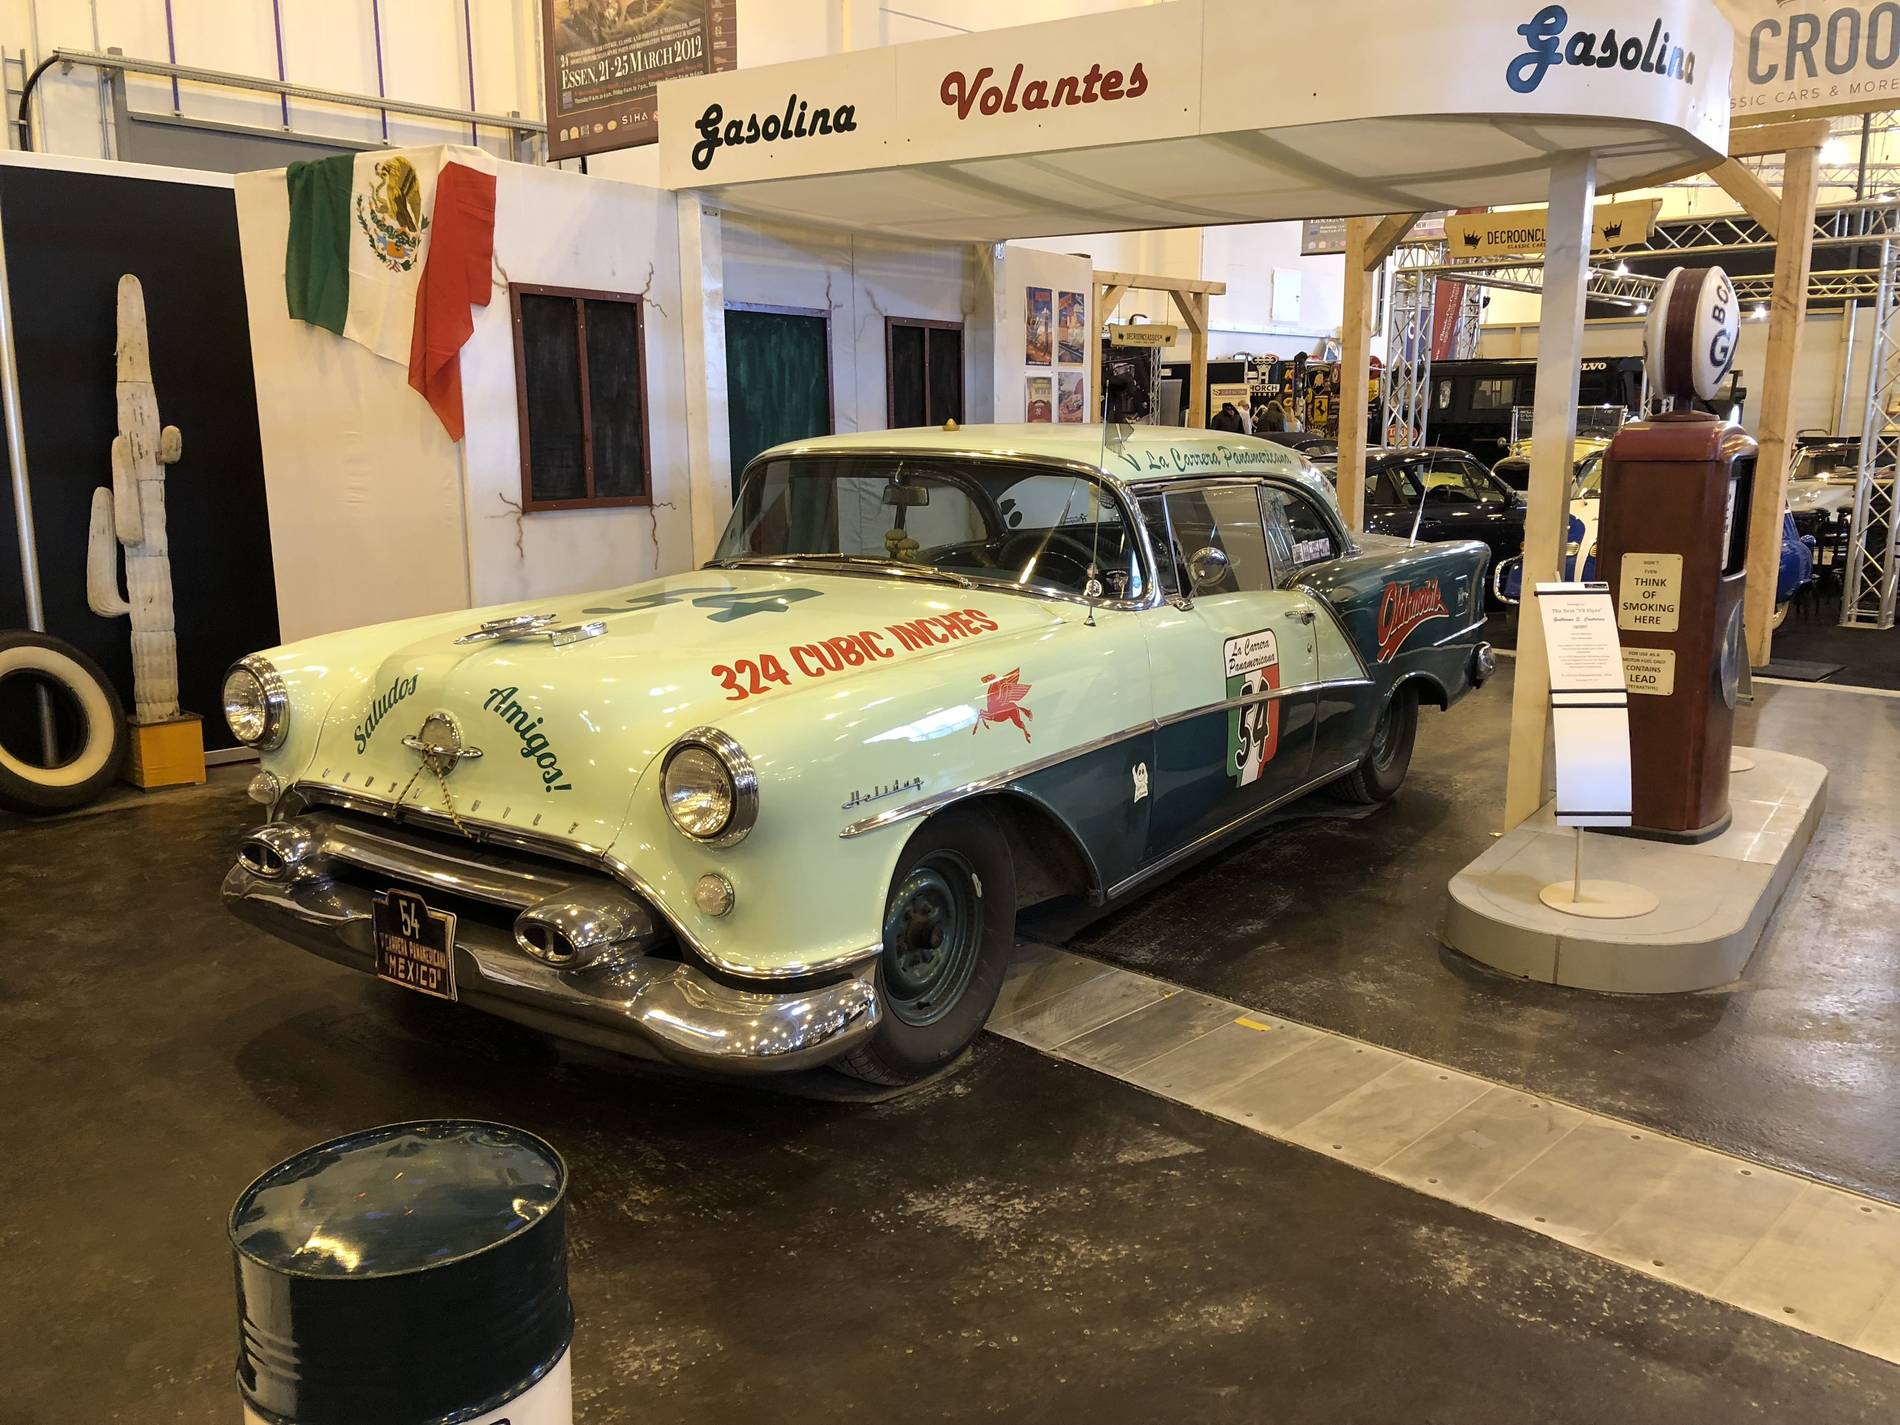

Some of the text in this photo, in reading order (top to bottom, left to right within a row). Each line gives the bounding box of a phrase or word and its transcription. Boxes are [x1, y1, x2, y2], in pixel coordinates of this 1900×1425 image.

[1505, 4, 1696, 94] Gasolina
[1747, 2, 1900, 85] CROO
[561, 67, 598, 89] ESSEN,
[629, 47, 673, 73] MARCH
[674, 35, 703, 63] 2012
[940, 62, 1149, 120] Volantes
[1775, 88, 1820, 103] CARS
[1829, 85, 1839, 96] &
[1849, 78, 1900, 95] MORE
[621, 111, 649, 125] SIHA
[691, 94, 857, 170] Gasolina
[1580, 362, 1607, 371] LVO
[1145, 450, 1170, 470] La
[1170, 448, 1220, 472] Carrera
[1217, 445, 1292, 467] Panamericana
[1634, 577, 1667, 587] THINK
[1642, 590, 1657, 600] OF
[1622, 602, 1675, 613] SMOKING
[1634, 615, 1661, 625] HERE
[711, 609, 998, 701] 324 CUBIC INCHES
[1231, 638, 1271, 657] La Carrera
[1228, 653, 1275, 674] Panamericana
[1626, 664, 1661, 673] CONTAINS
[1629, 674, 1657, 684] LEAD
[354, 674, 418, 755] Saludos
[1235, 676, 1270, 770] 54
[483, 686, 572, 793] Amigos!
[399, 899, 420, 940] 54
